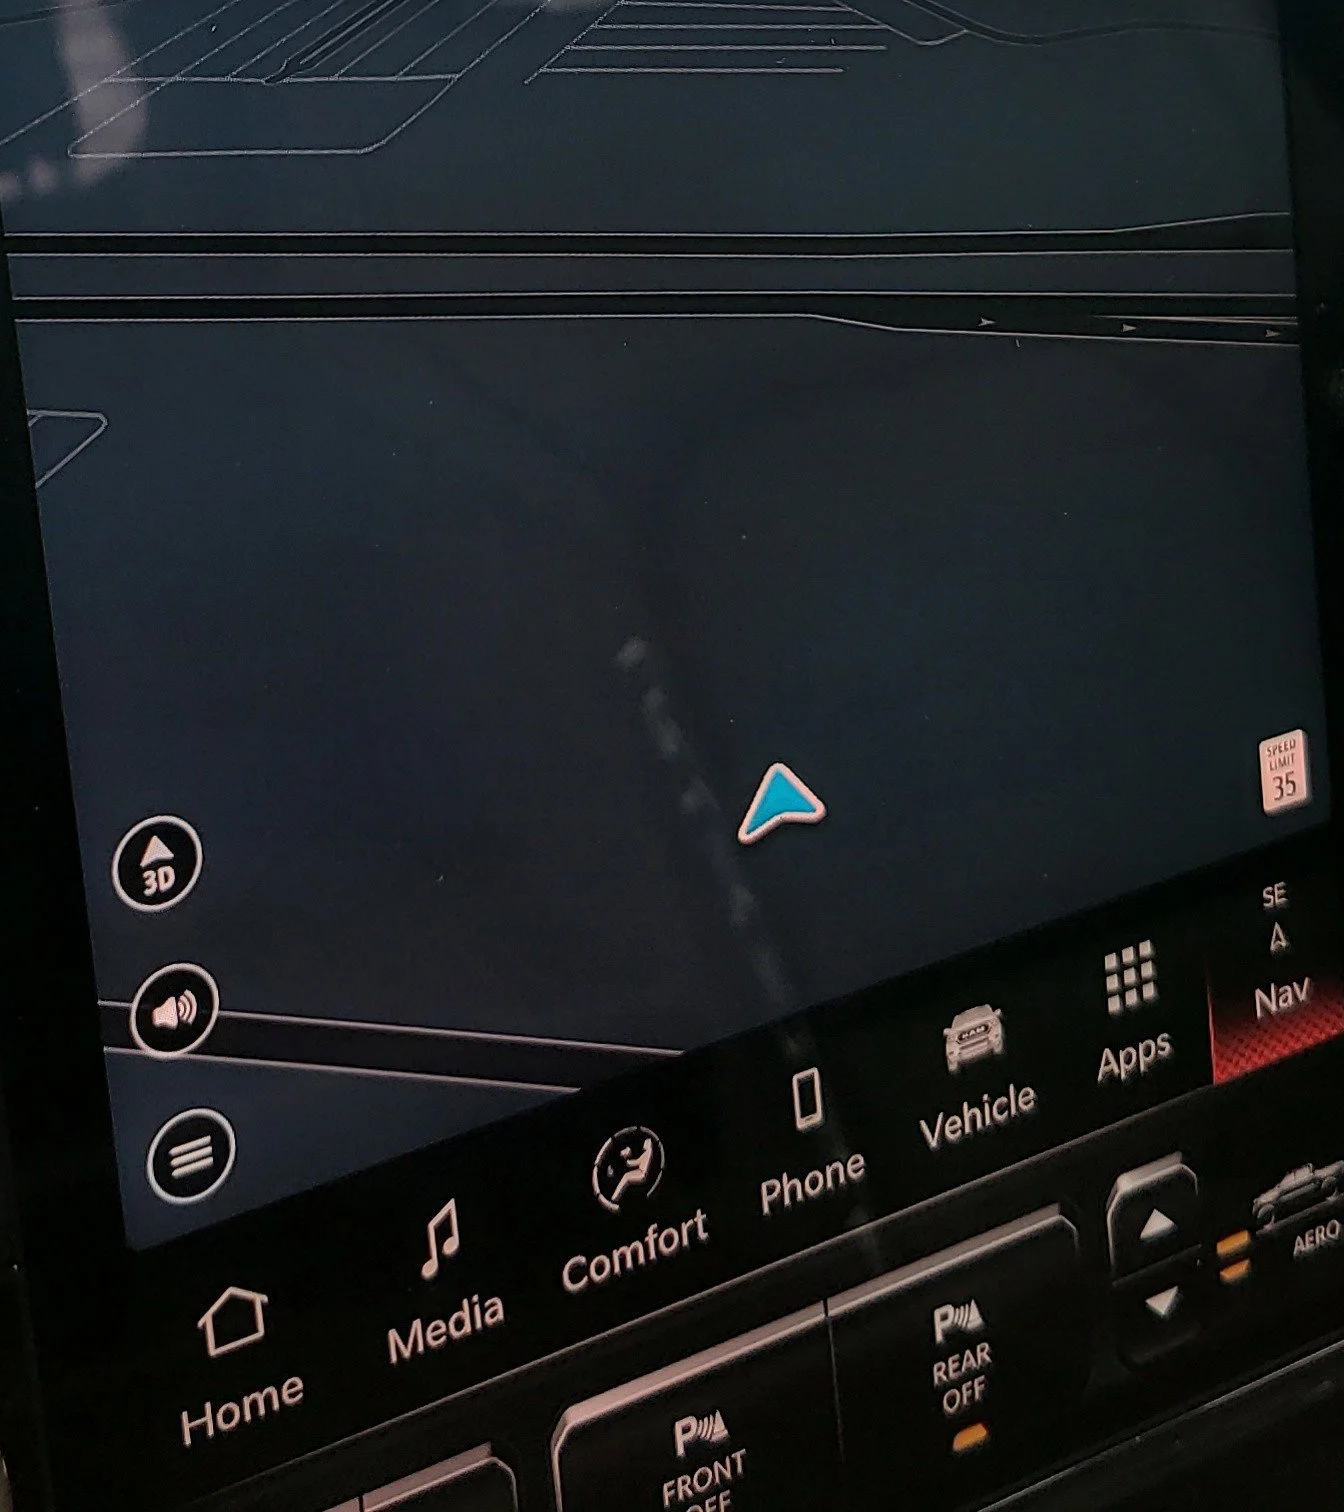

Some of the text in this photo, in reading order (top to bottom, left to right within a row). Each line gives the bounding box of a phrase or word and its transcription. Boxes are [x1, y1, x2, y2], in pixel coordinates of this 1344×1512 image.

[1267, 739, 1296, 757] SPEED
[1269, 753, 1296, 772] LIMIT
[1272, 771, 1296, 801] 35
[142, 865, 176, 897] 3D
[1262, 881, 1290, 909] SE
[1254, 976, 1313, 1021] Nav
[1096, 1031, 1173, 1084] Apps
[918, 1083, 1038, 1151] Vehicle
[759, 1151, 868, 1215] Phone
[562, 1207, 711, 1292] Comfort
[1292, 1218, 1344, 1258] AERO
[388, 1292, 506, 1364] Media
[932, 1341, 993, 1388] REAR
[180, 1373, 306, 1448] Home
[942, 1377, 986, 1413] OFF
[662, 1448, 747, 1508] FRONT
[686, 1490, 732, 1512] FF
